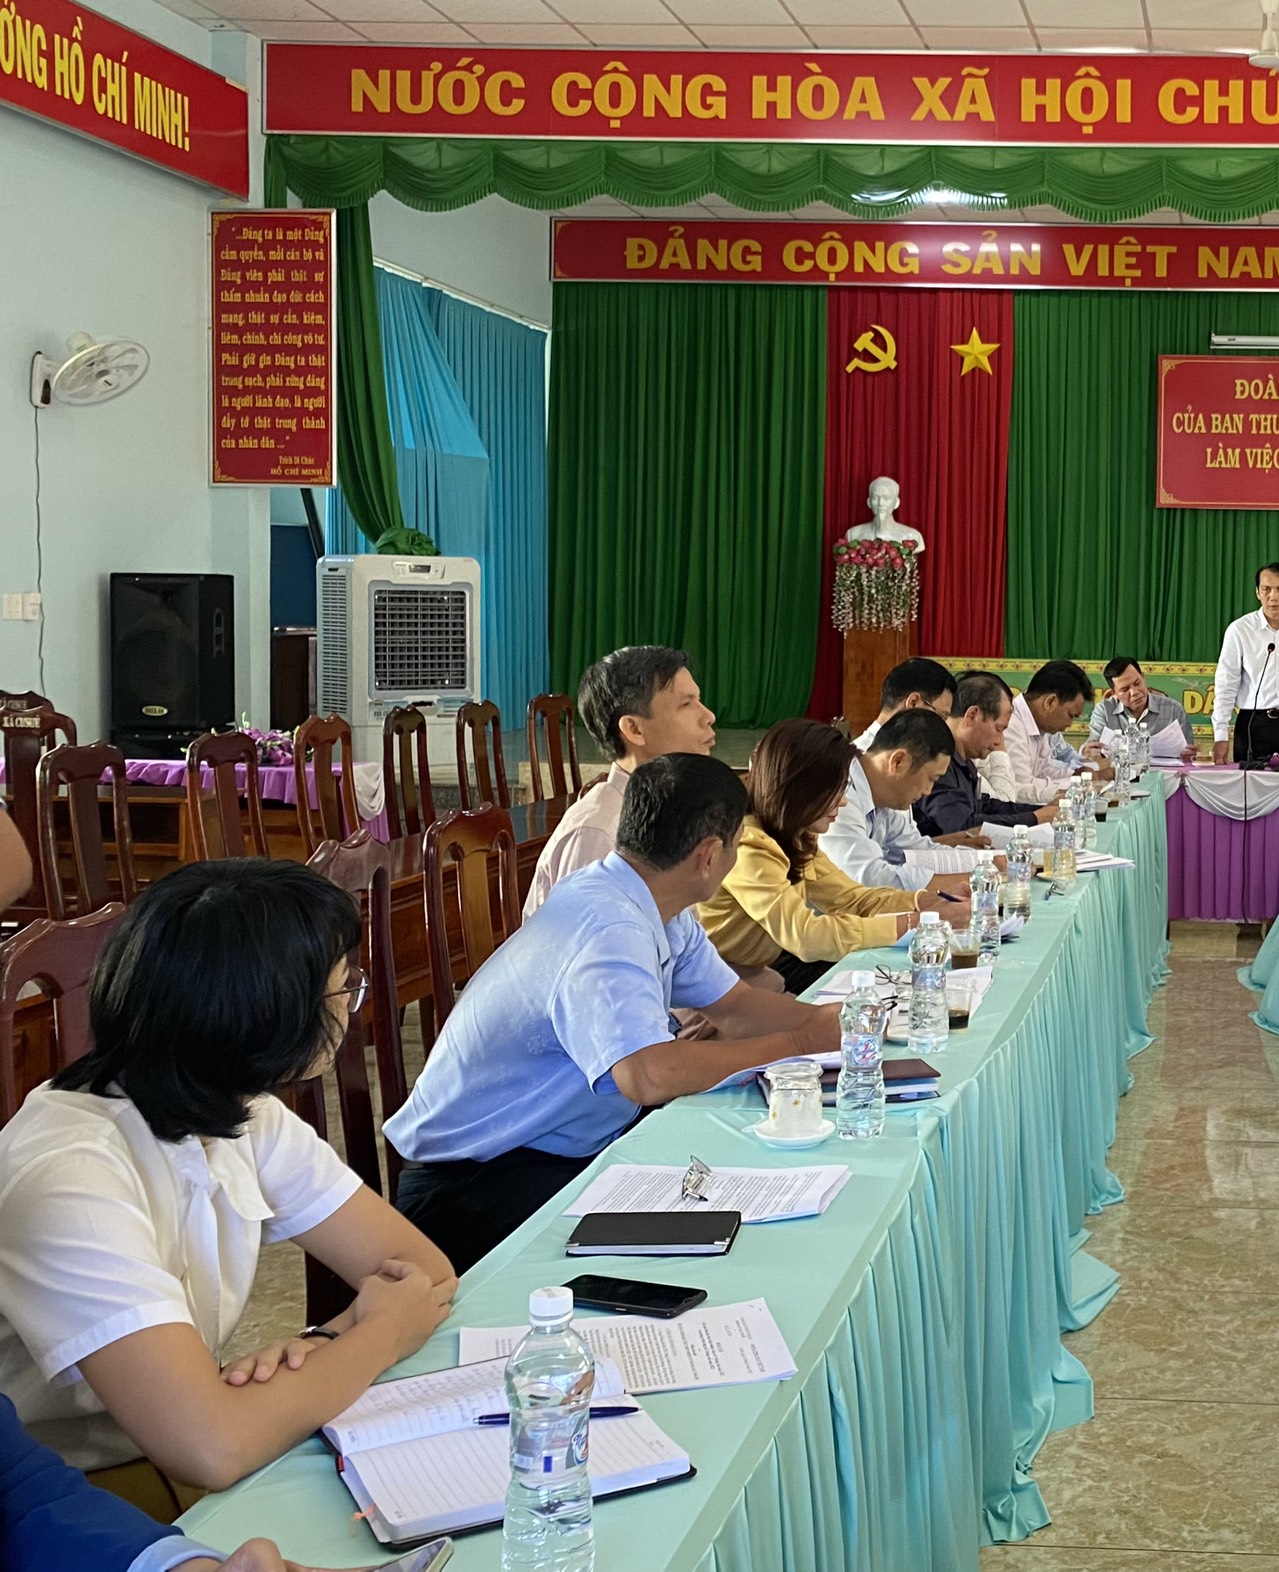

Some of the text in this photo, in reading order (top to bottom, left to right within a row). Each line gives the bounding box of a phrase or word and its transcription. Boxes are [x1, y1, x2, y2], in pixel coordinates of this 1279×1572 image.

[54, 16, 85, 105] HỒ
[92, 51, 128, 124] CHÍ
[352, 57, 526, 115] NƯỚC
[552, 62, 727, 128] CỘNG
[752, 63, 886, 121] HÒA
[910, 67, 995, 122] XÃ
[1020, 67, 1132, 134] HỘI
[624, 226, 762, 271] ĐẢNG
[782, 232, 920, 281] CỘNG
[941, 230, 1042, 275] SẢN
[1063, 237, 1178, 286] VIỆT
[1172, 405, 1206, 434] CỦA
[1210, 413, 1244, 434] BAN
[1206, 441, 1241, 469] LÀM
